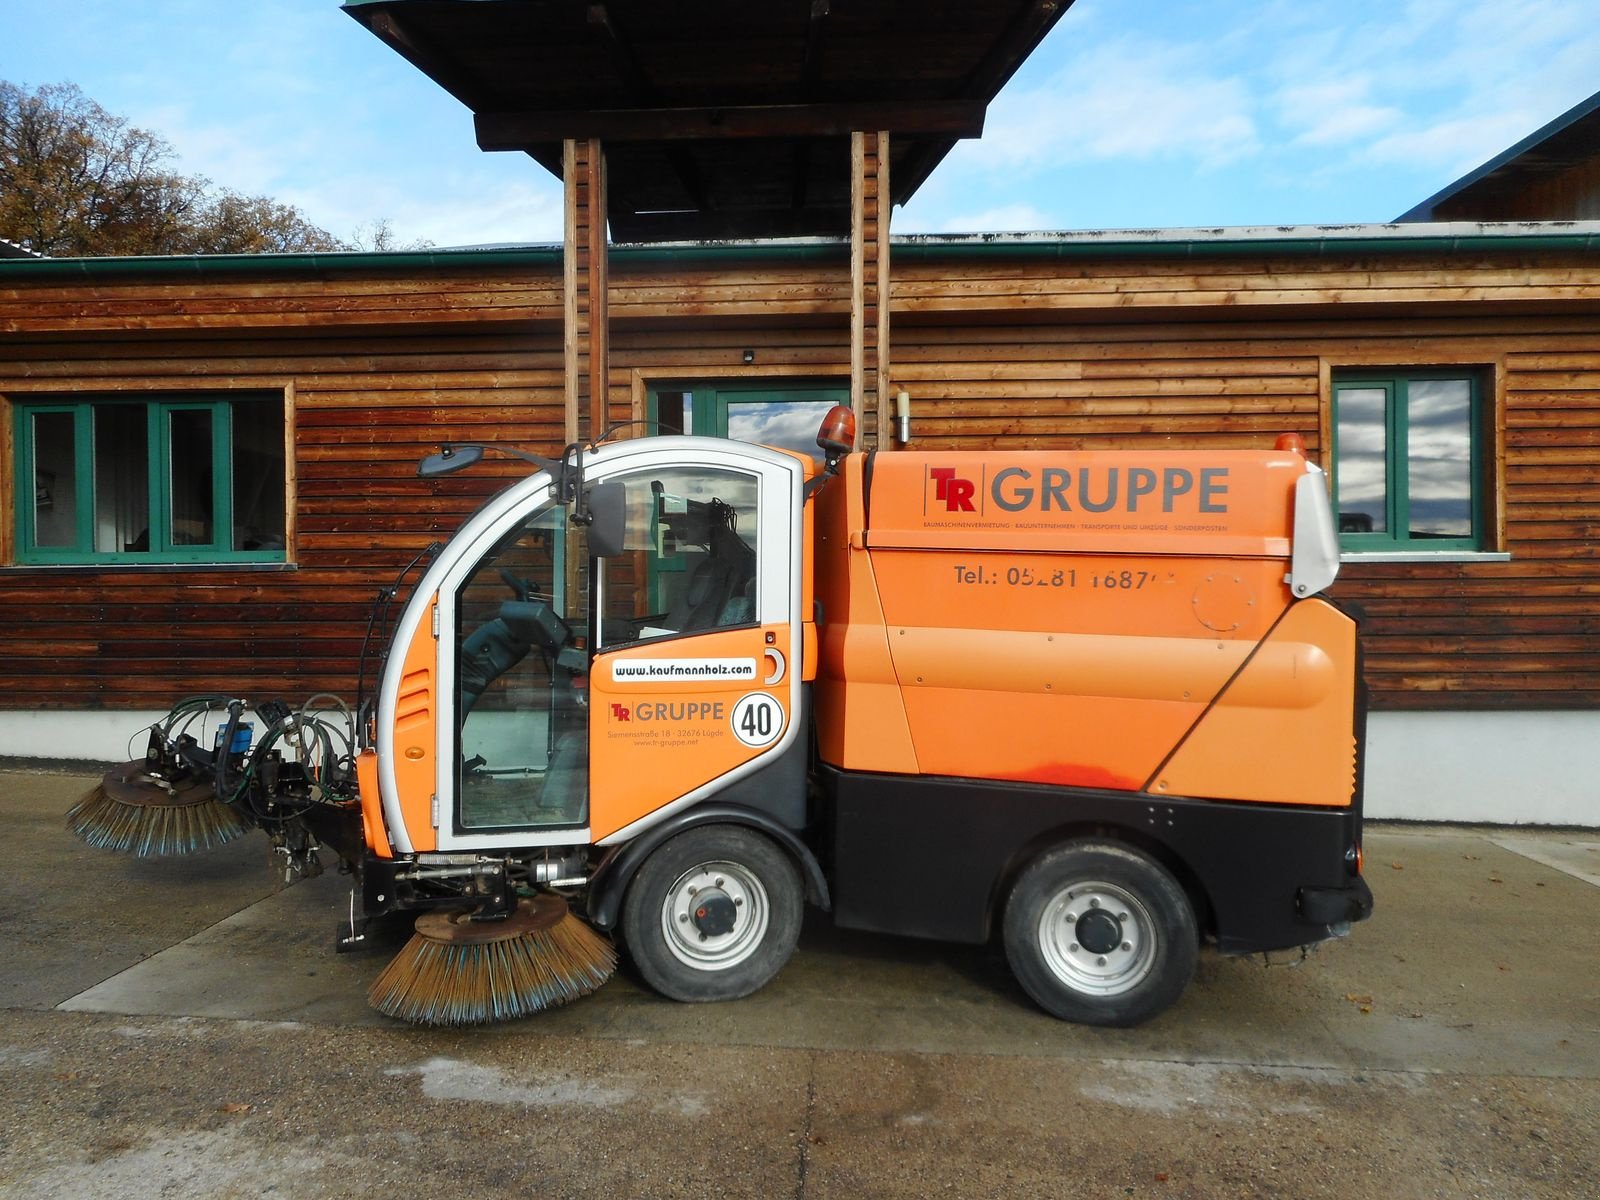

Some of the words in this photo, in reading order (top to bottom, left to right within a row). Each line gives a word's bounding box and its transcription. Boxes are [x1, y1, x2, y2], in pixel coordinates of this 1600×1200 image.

[930, 467, 976, 512] TR
[991, 467, 1229, 513] GRUPPE
[923, 521, 1010, 529] BAUMASCHINENVERMIETUNG
[1080, 523, 1121, 531] TRANSPORTE
[954, 566, 997, 584] Tel.:
[615, 664, 752, 677] www.kaufmannholz.com
[611, 703, 630, 721] TR
[636, 703, 724, 721] GRUPPE
[741, 703, 772, 737] 40
[661, 730, 671, 738] 18
[634, 739, 699, 747] www.tr-gruppe.net
